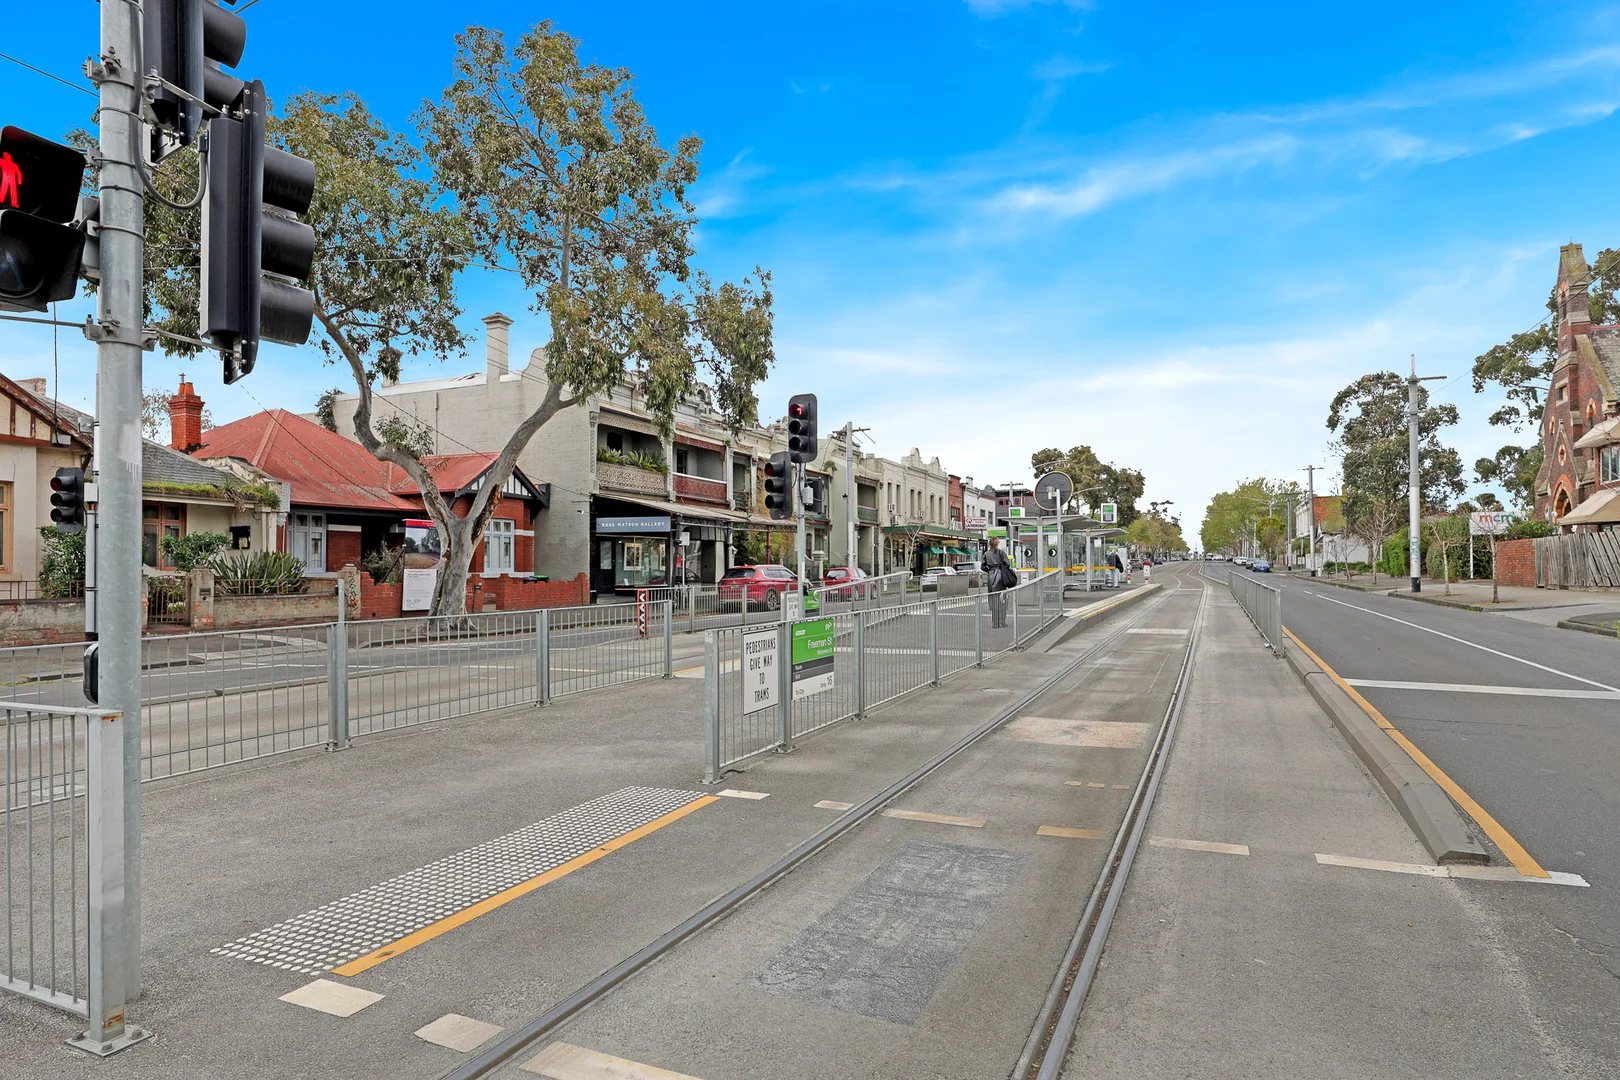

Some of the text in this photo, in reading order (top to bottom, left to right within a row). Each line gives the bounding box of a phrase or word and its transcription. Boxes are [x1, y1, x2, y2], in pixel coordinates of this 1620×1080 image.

[746, 638, 776, 654] PEDESTRIANS
[808, 636, 832, 649] Freeman St
[750, 655, 773, 670] GIVE WAY
[759, 672, 765, 685] TO
[755, 687, 769, 703] TRAMS
